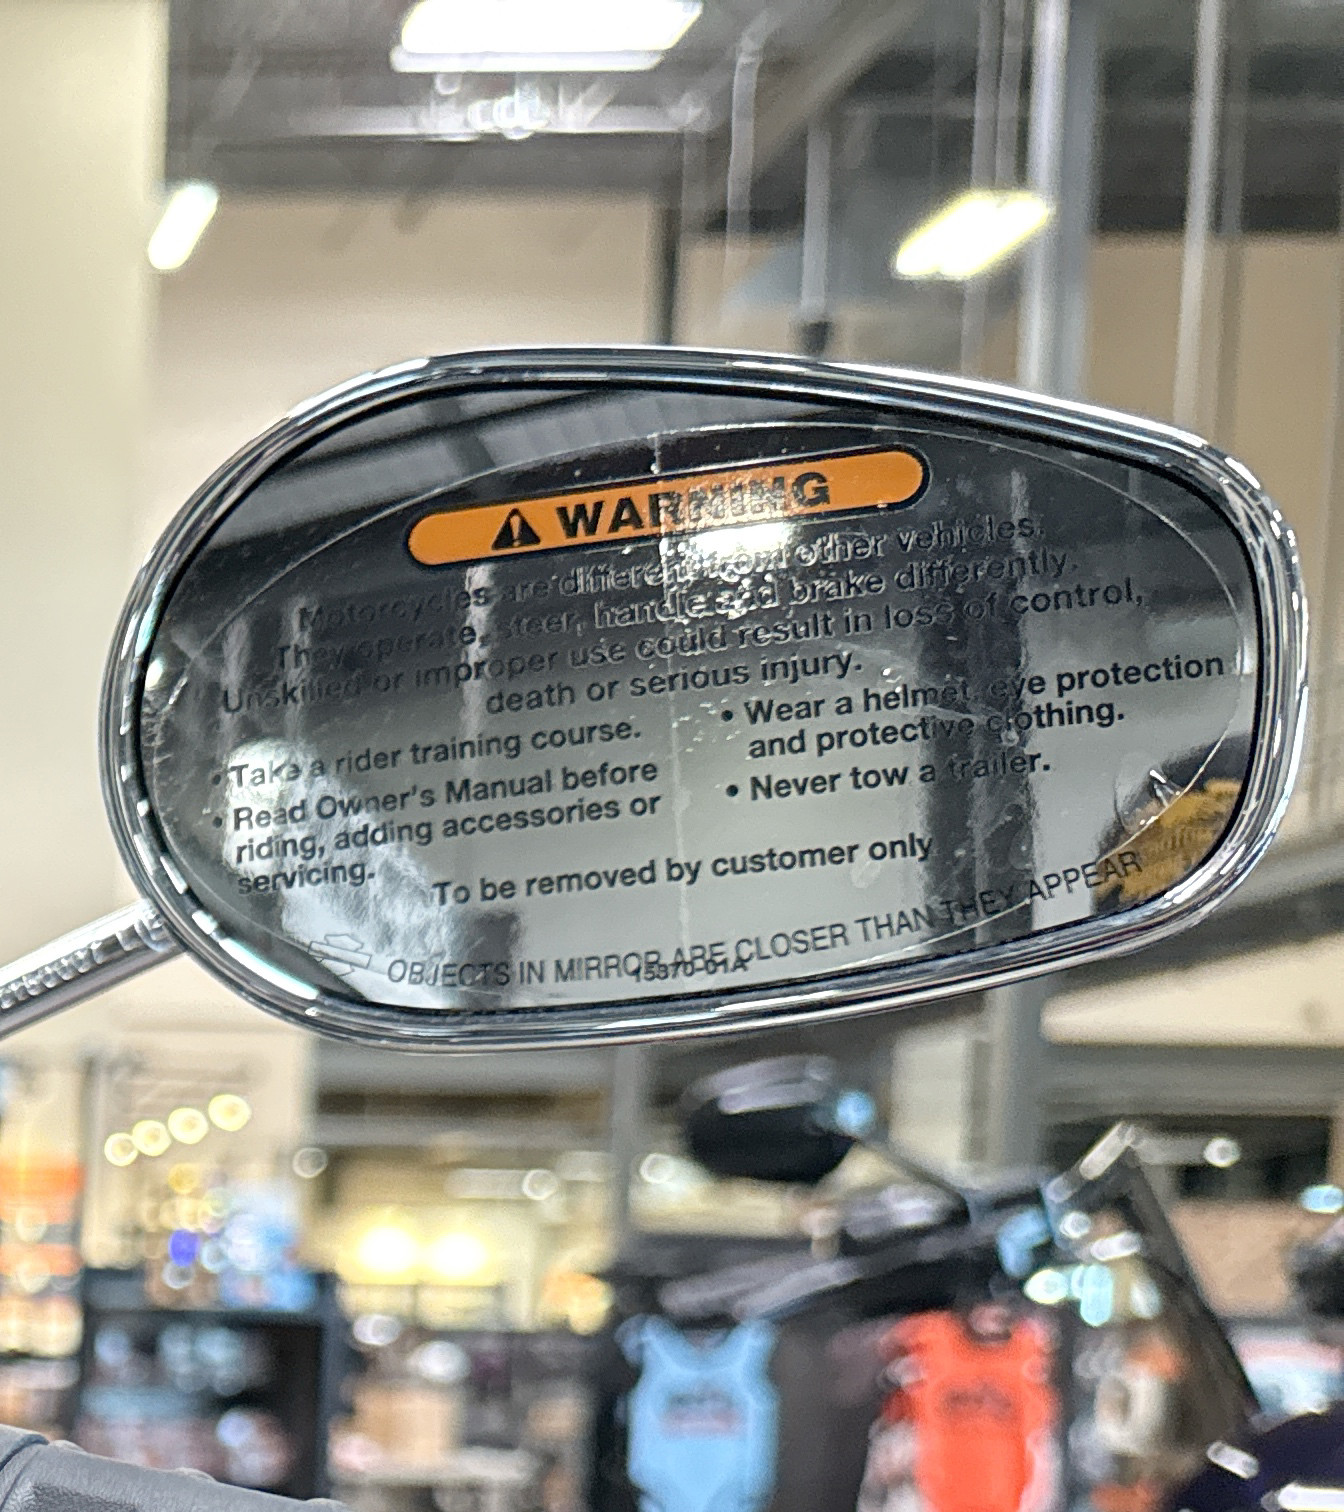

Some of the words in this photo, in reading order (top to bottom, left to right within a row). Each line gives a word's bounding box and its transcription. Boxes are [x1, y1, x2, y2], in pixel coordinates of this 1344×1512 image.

[556, 471, 830, 538] WARNING
[279, 640, 346, 669] They
[594, 588, 709, 629] handle
[789, 568, 885, 605] brake
[895, 546, 1079, 593] differently.
[298, 586, 490, 629] Motorcycles
[501, 577, 549, 602] are
[795, 530, 885, 567] other
[897, 514, 1045, 554] vehicles.
[223, 670, 360, 713] Unskilled
[371, 671, 404, 693] or
[415, 648, 558, 690] improper
[568, 640, 626, 669] use
[635, 622, 727, 658] could
[738, 608, 835, 650] result
[844, 606, 872, 635] in
[885, 603, 954, 630] loss
[963, 590, 999, 621] of
[1011, 576, 1143, 616] control,
[485, 681, 576, 715] death
[586, 677, 620, 702] or
[629, 661, 750, 698] serious
[761, 650, 862, 684] injury.
[744, 697, 824, 726] Wear
[835, 695, 853, 715] a
[862, 682, 979, 713] helmet,
[990, 674, 1046, 702] eye
[1057, 653, 1224, 699] protection
[230, 757, 300, 790] Take
[313, 760, 326, 778] a
[334, 748, 403, 774] rider
[409, 732, 520, 766] training
[530, 717, 642, 751] course.
[748, 728, 806, 759] and
[816, 712, 974, 757] protective
[987, 699, 1125, 732] clothing.
[233, 798, 307, 832] Read
[315, 785, 436, 822] Owner's
[445, 770, 552, 805] Manual
[561, 759, 659, 791] before
[750, 770, 842, 801] Never
[850, 763, 910, 790] tow
[919, 764, 937, 784] a
[947, 750, 1051, 780] trailer.
[236, 832, 326, 864] riding,
[334, 820, 433, 850] adding
[442, 797, 621, 838] accessories
[629, 793, 662, 815] or
[237, 863, 376, 895] servicing.
[432, 880, 470, 907] To
[480, 876, 516, 901] be
[525, 858, 656, 897] removed
[666, 856, 702, 886] by
[711, 842, 858, 878] customer
[868, 832, 933, 862] only
[387, 958, 510, 988] OBJECTS
[519, 958, 544, 985] IN
[554, 949, 661, 984] MIRROR
[673, 941, 726, 968] ARE
[735, 923, 849, 963] CLOSER
[855, 900, 934, 943] THAN
[941, 885, 1018, 928] THEY
[1026, 850, 1142, 903] APPEAR
